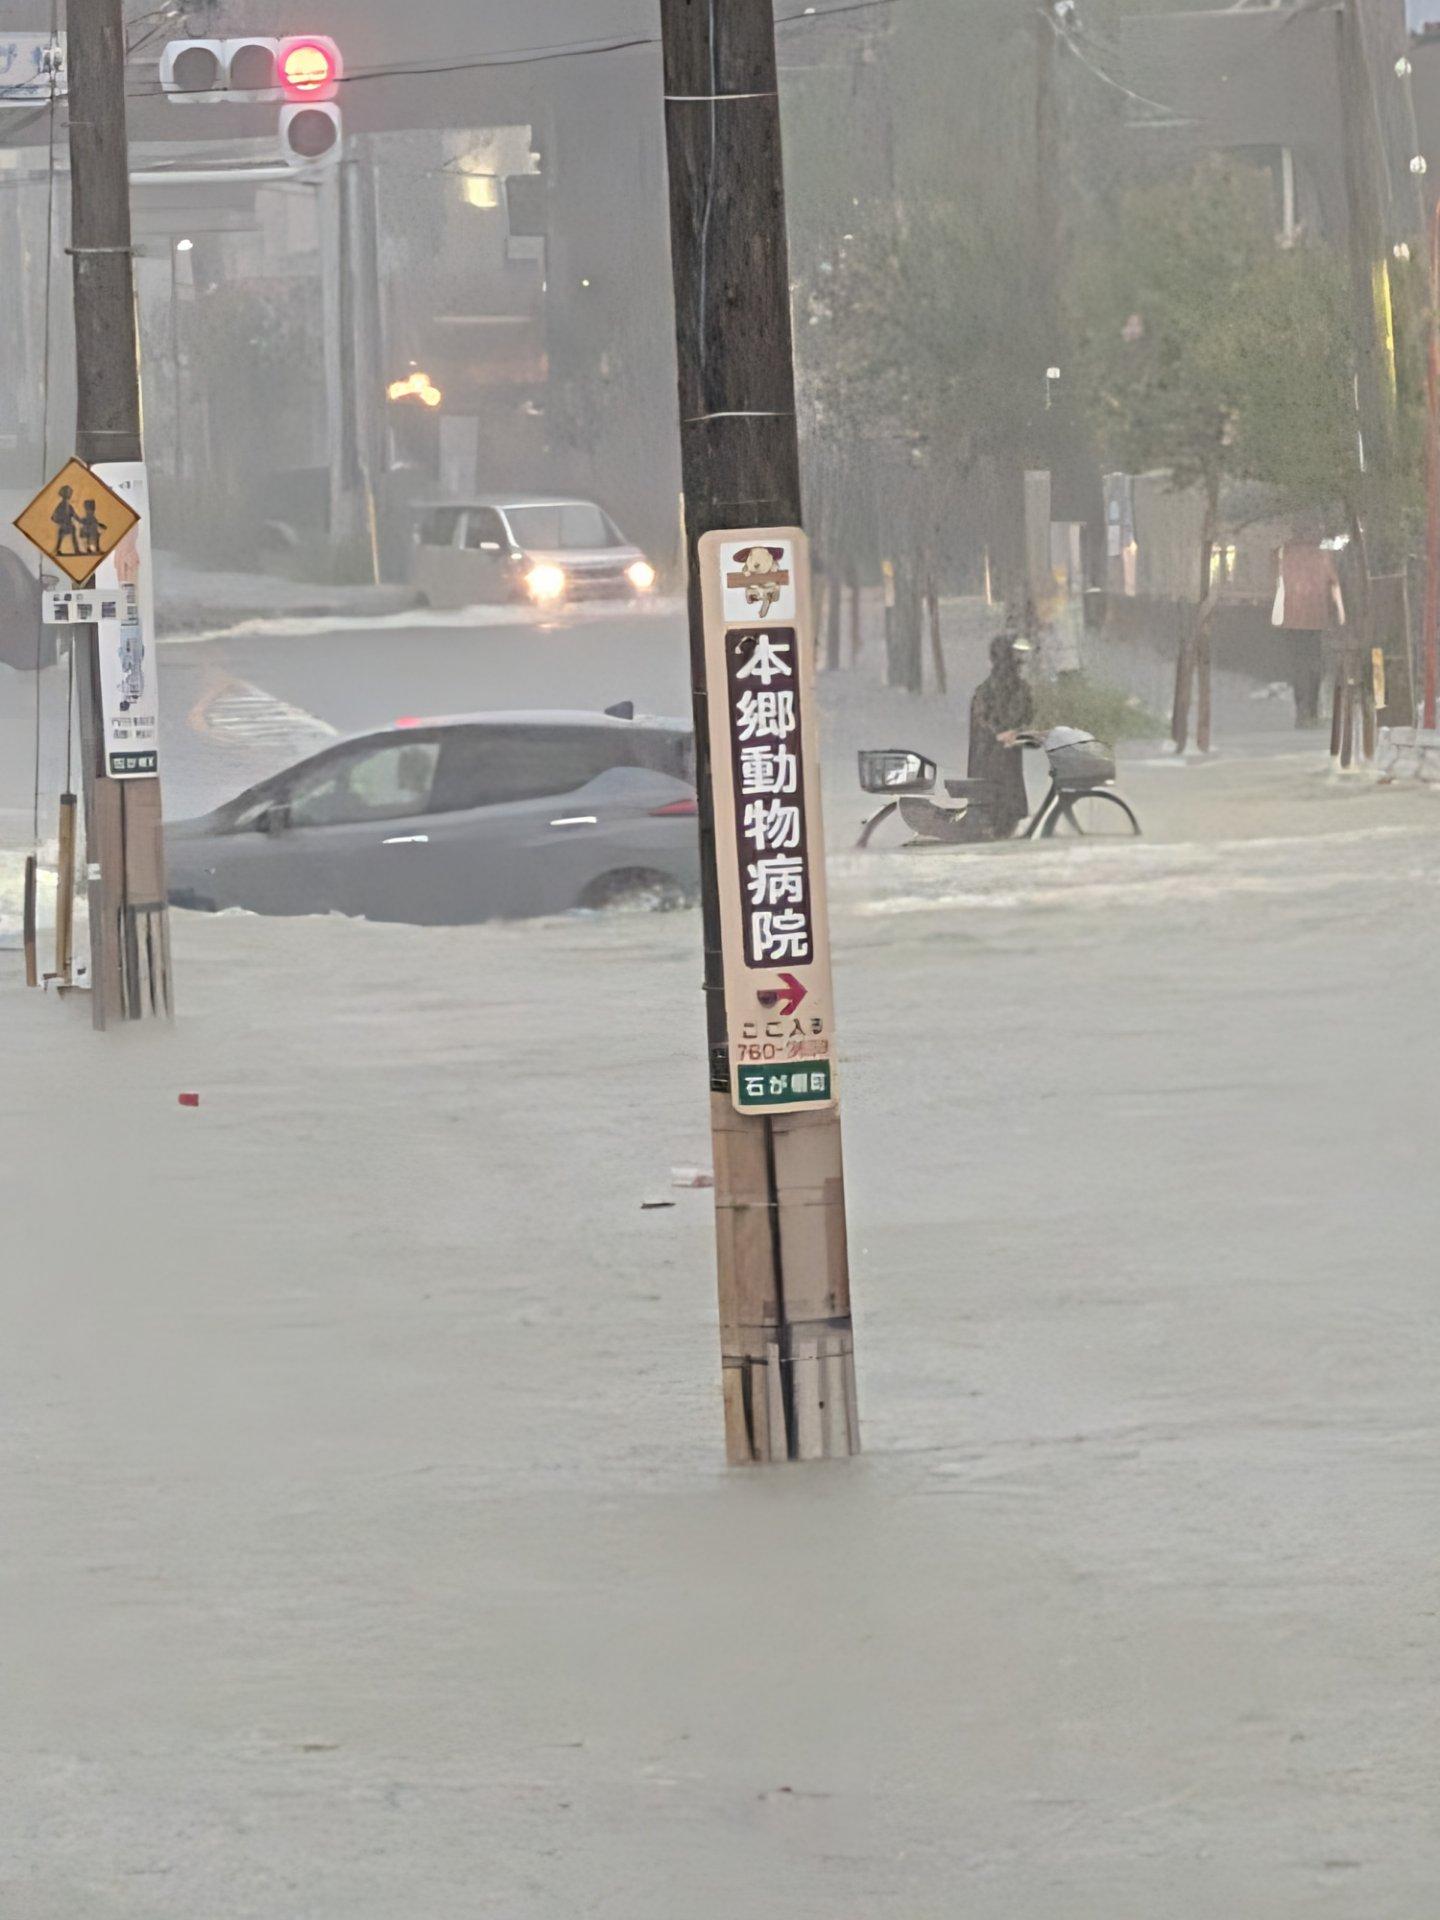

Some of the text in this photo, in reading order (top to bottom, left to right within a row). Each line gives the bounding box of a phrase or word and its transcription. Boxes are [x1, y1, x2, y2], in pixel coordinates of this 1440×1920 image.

[735, 634, 809, 962] 本郷動物病院
[744, 1072, 826, 1097] 石が町
